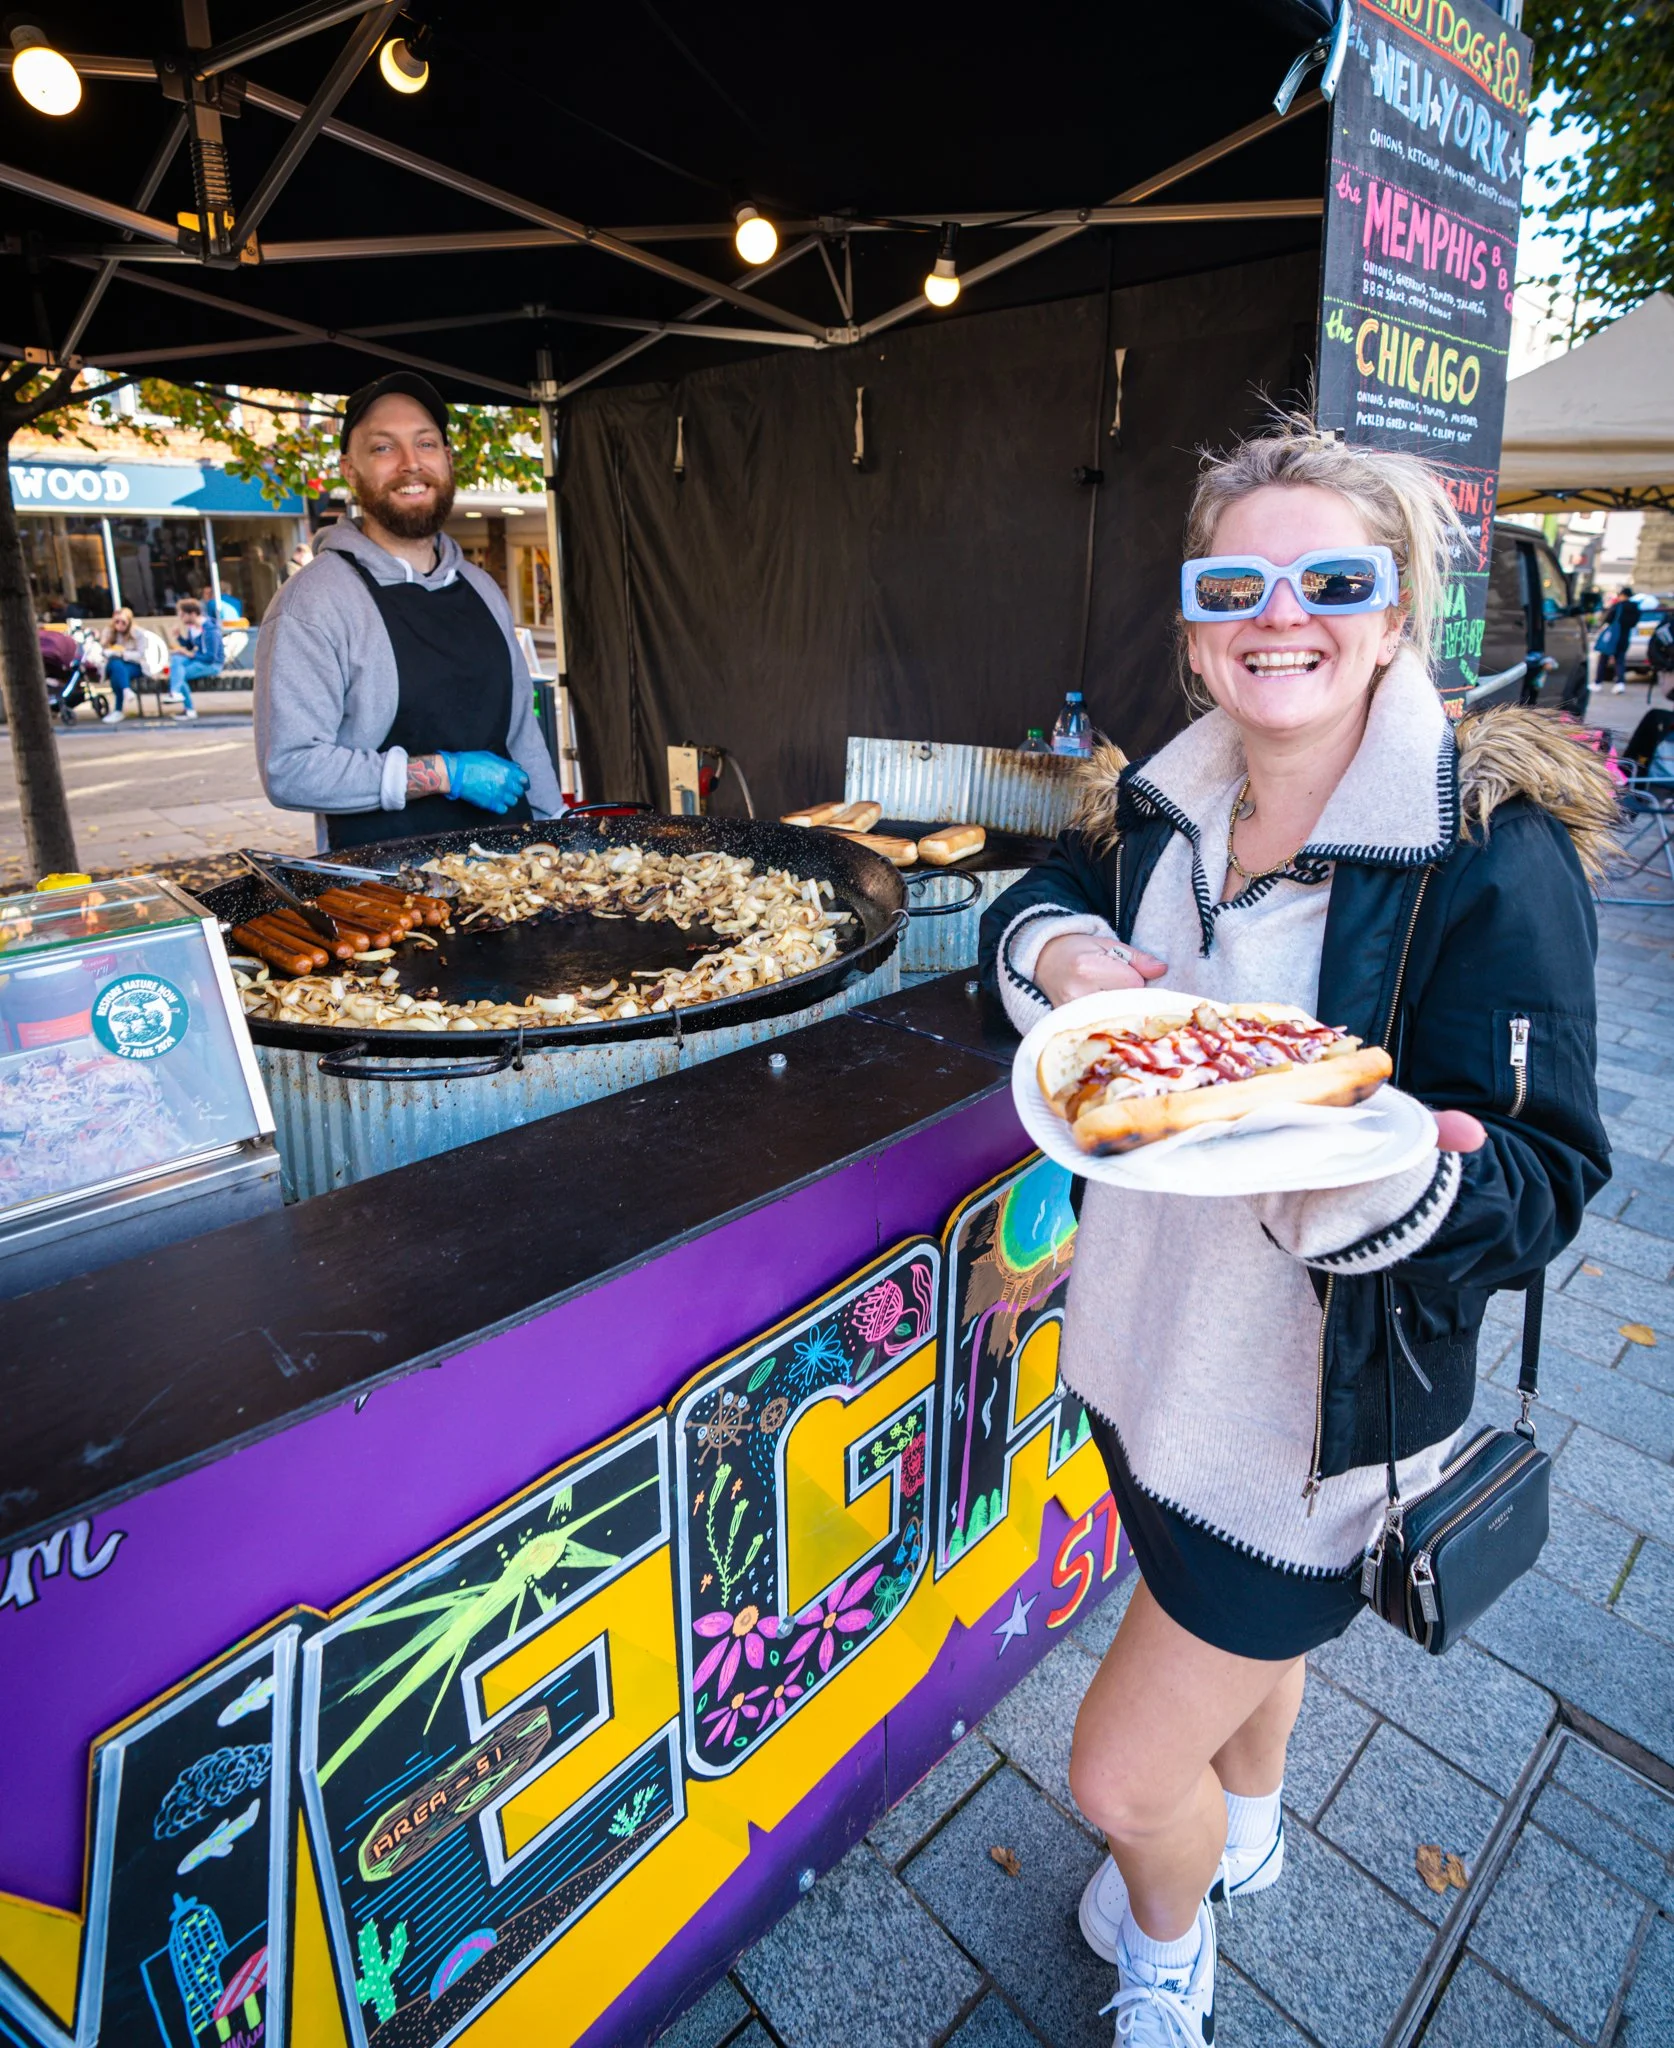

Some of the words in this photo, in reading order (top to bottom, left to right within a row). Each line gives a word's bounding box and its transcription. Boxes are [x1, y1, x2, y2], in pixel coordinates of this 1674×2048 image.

[1371, 38, 1433, 130] NEW
[1439, 77, 1510, 184] YORK
[1336, 172, 1362, 205] the
[1363, 181, 1488, 290] MEMPHIS
[1363, 279, 1384, 298] BBQ
[1325, 308, 1353, 344] the
[1355, 318, 1481, 406] CHICAGO
[1356, 411, 1384, 427] PICKLED
[96, 984, 124, 1016] RESTORE
[122, 979, 158, 992] NATURE
[156, 984, 178, 1004] NOW
[117, 1043, 131, 1056] 22
[130, 1046, 155, 1058] JUNE
[154, 1035, 176, 1053] 2024
